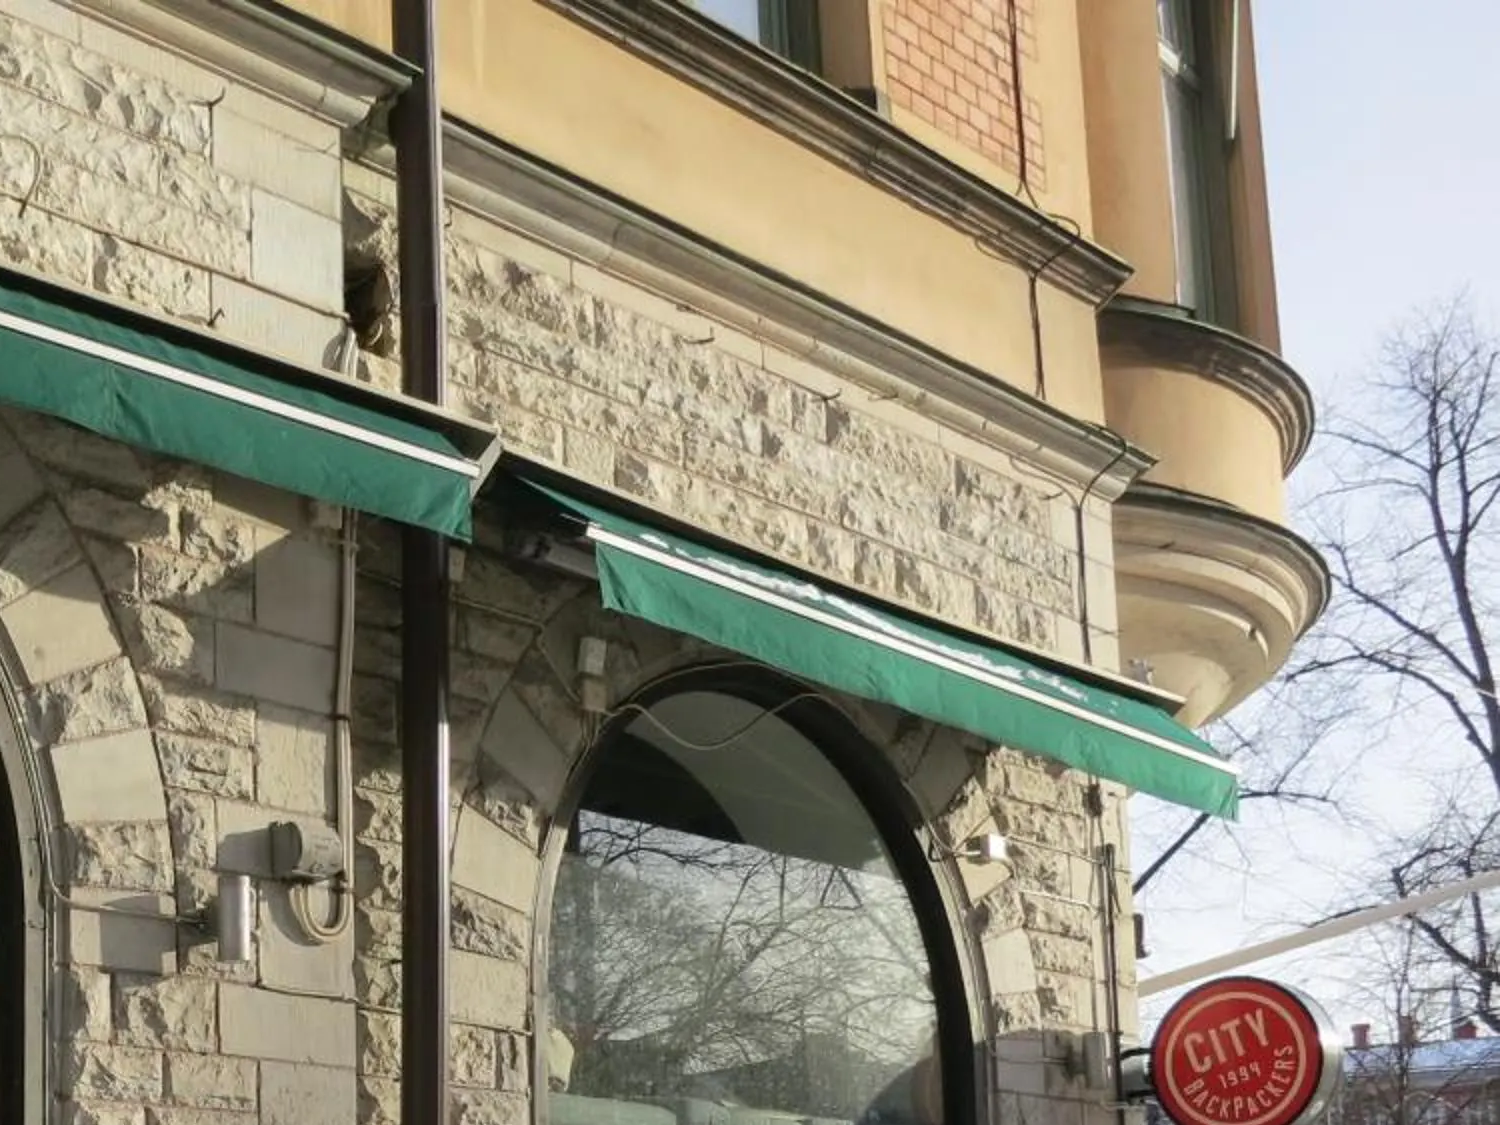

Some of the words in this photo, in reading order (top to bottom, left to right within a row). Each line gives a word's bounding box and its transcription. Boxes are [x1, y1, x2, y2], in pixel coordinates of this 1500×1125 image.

[1184, 1008, 1268, 1073] CITY
[1184, 1045, 1293, 1118] BACKPACKERS
[1219, 1061, 1260, 1088] 1994
